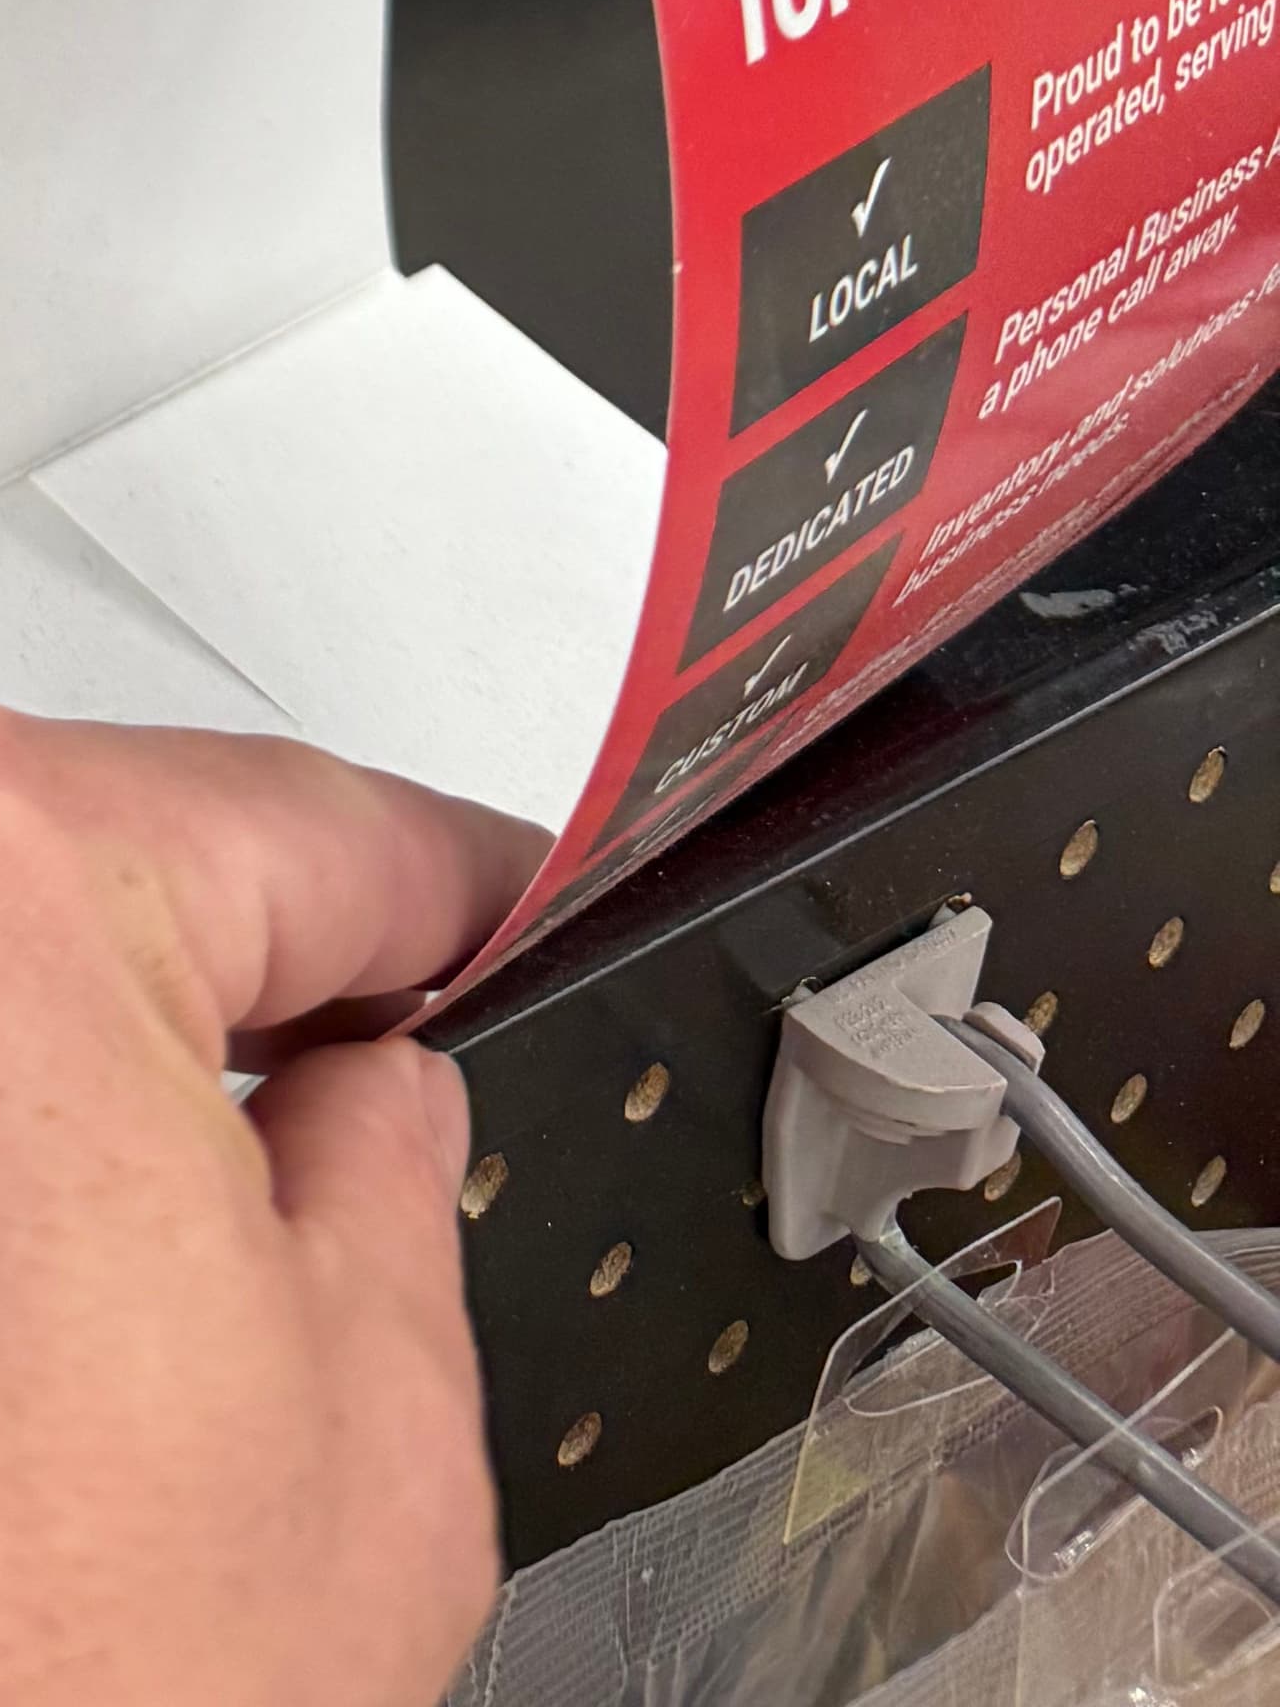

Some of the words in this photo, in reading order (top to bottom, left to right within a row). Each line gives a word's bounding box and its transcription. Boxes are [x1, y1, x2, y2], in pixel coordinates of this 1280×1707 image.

[1025, 56, 1166, 194] operated,
[1030, 20, 1124, 131] Proud
[1130, 15, 1160, 64] to
[807, 236, 919, 344] LOCAL
[977, 380, 1002, 420] a
[1000, 307, 1103, 412] phone
[1107, 249, 1166, 324] call
[1163, 204, 1239, 283] away.
[994, 225, 1136, 365] Personal
[1136, 144, 1264, 263] Business
[722, 444, 916, 613] DEDICATED
[919, 430, 1071, 562] Inventory
[1069, 374, 1134, 448] and
[653, 661, 809, 795] CUSTOM
